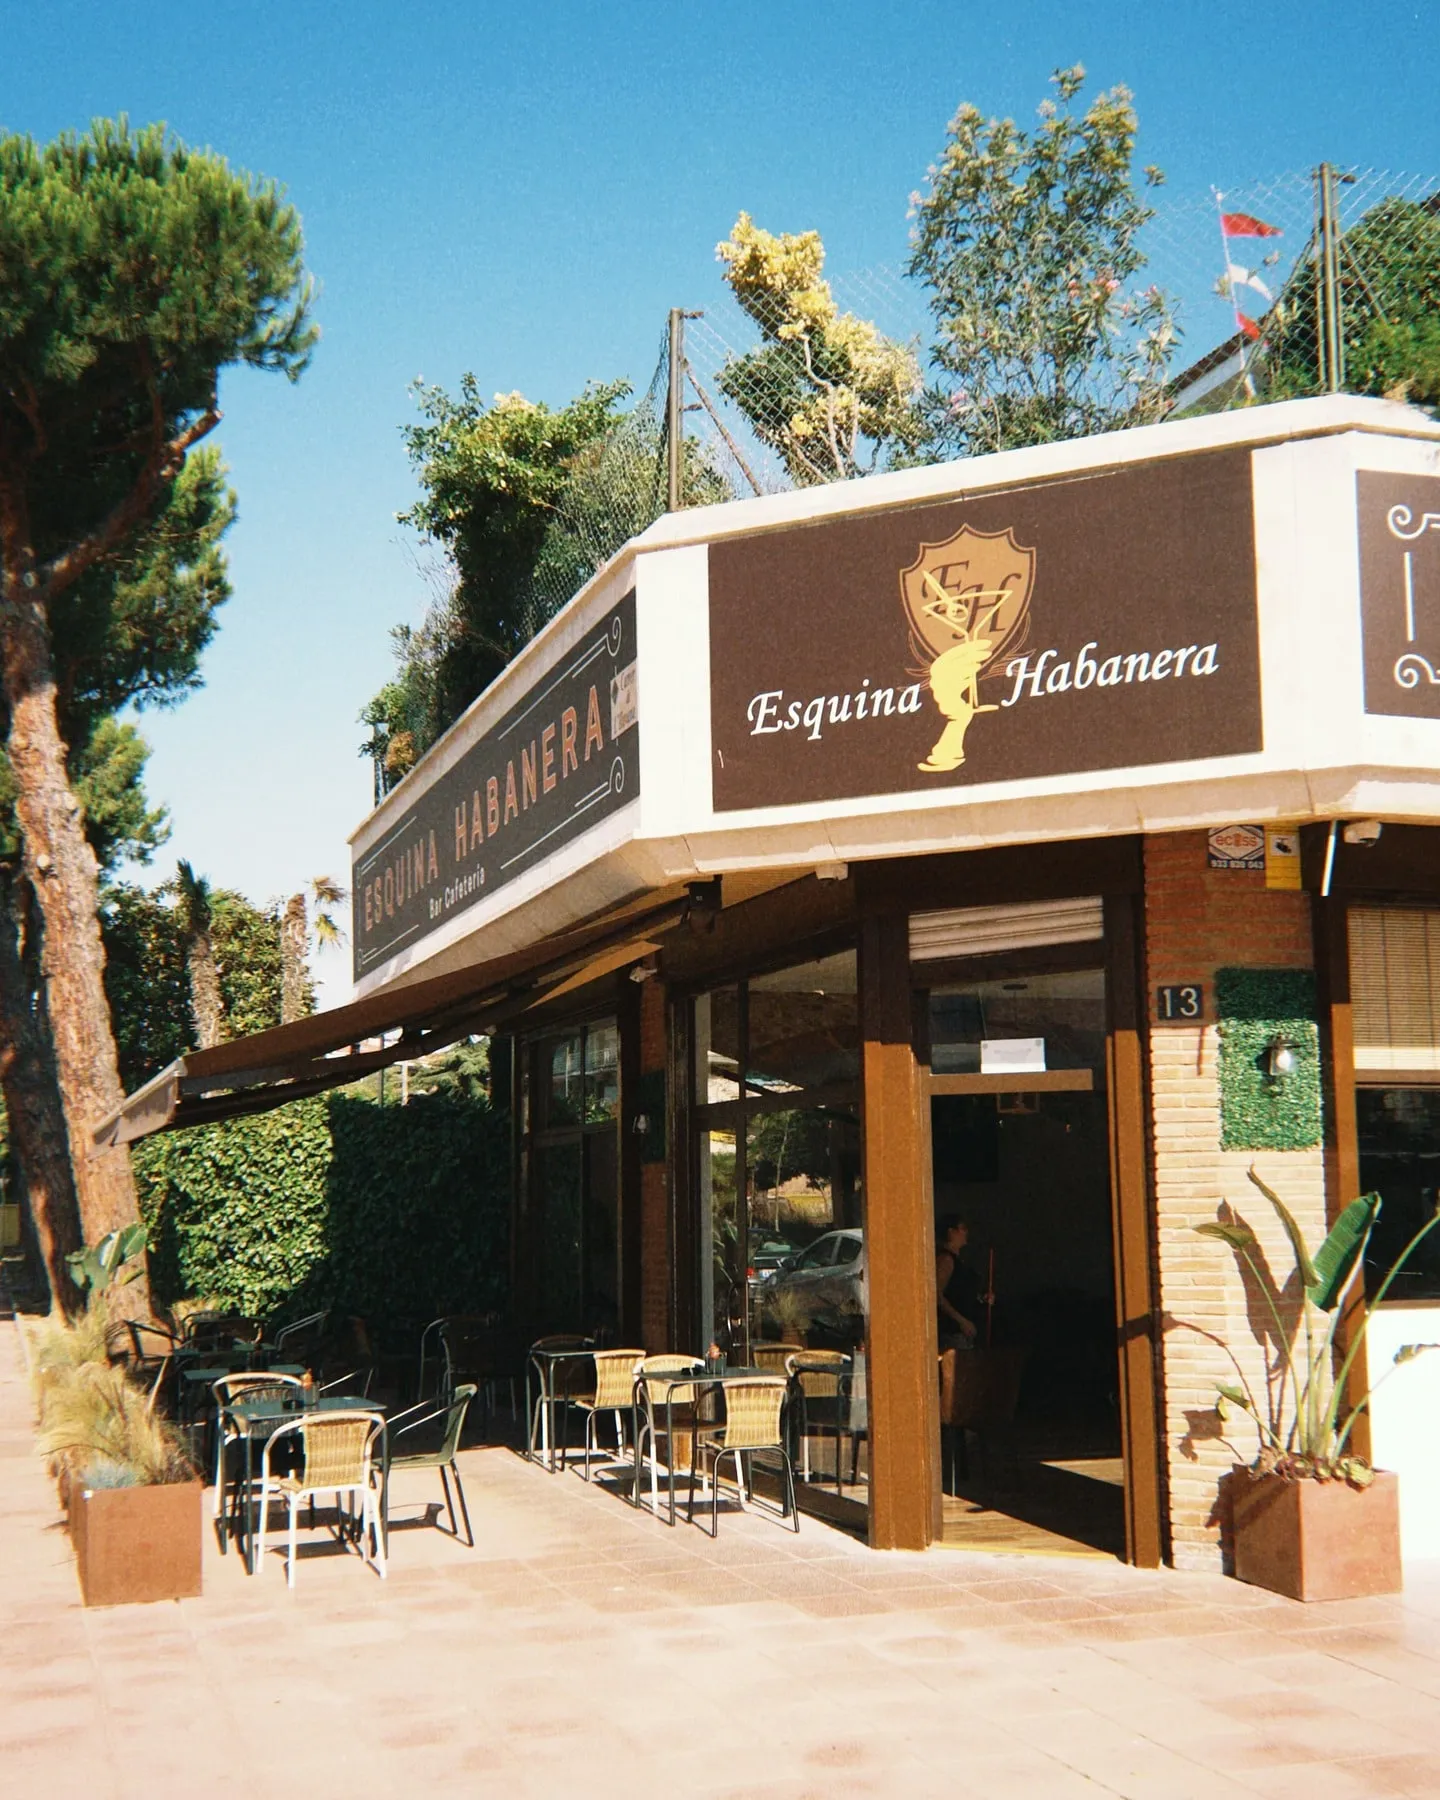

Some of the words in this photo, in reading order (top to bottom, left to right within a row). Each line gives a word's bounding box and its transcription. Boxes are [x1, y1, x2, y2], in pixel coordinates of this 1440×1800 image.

[747, 679, 923, 741] Esquina
[1001, 642, 1218, 707] Habanera
[365, 829, 438, 932] ESQUINA
[454, 685, 604, 863] HABANERA
[429, 897, 443, 920] Bar
[1162, 988, 1199, 1017] 13
